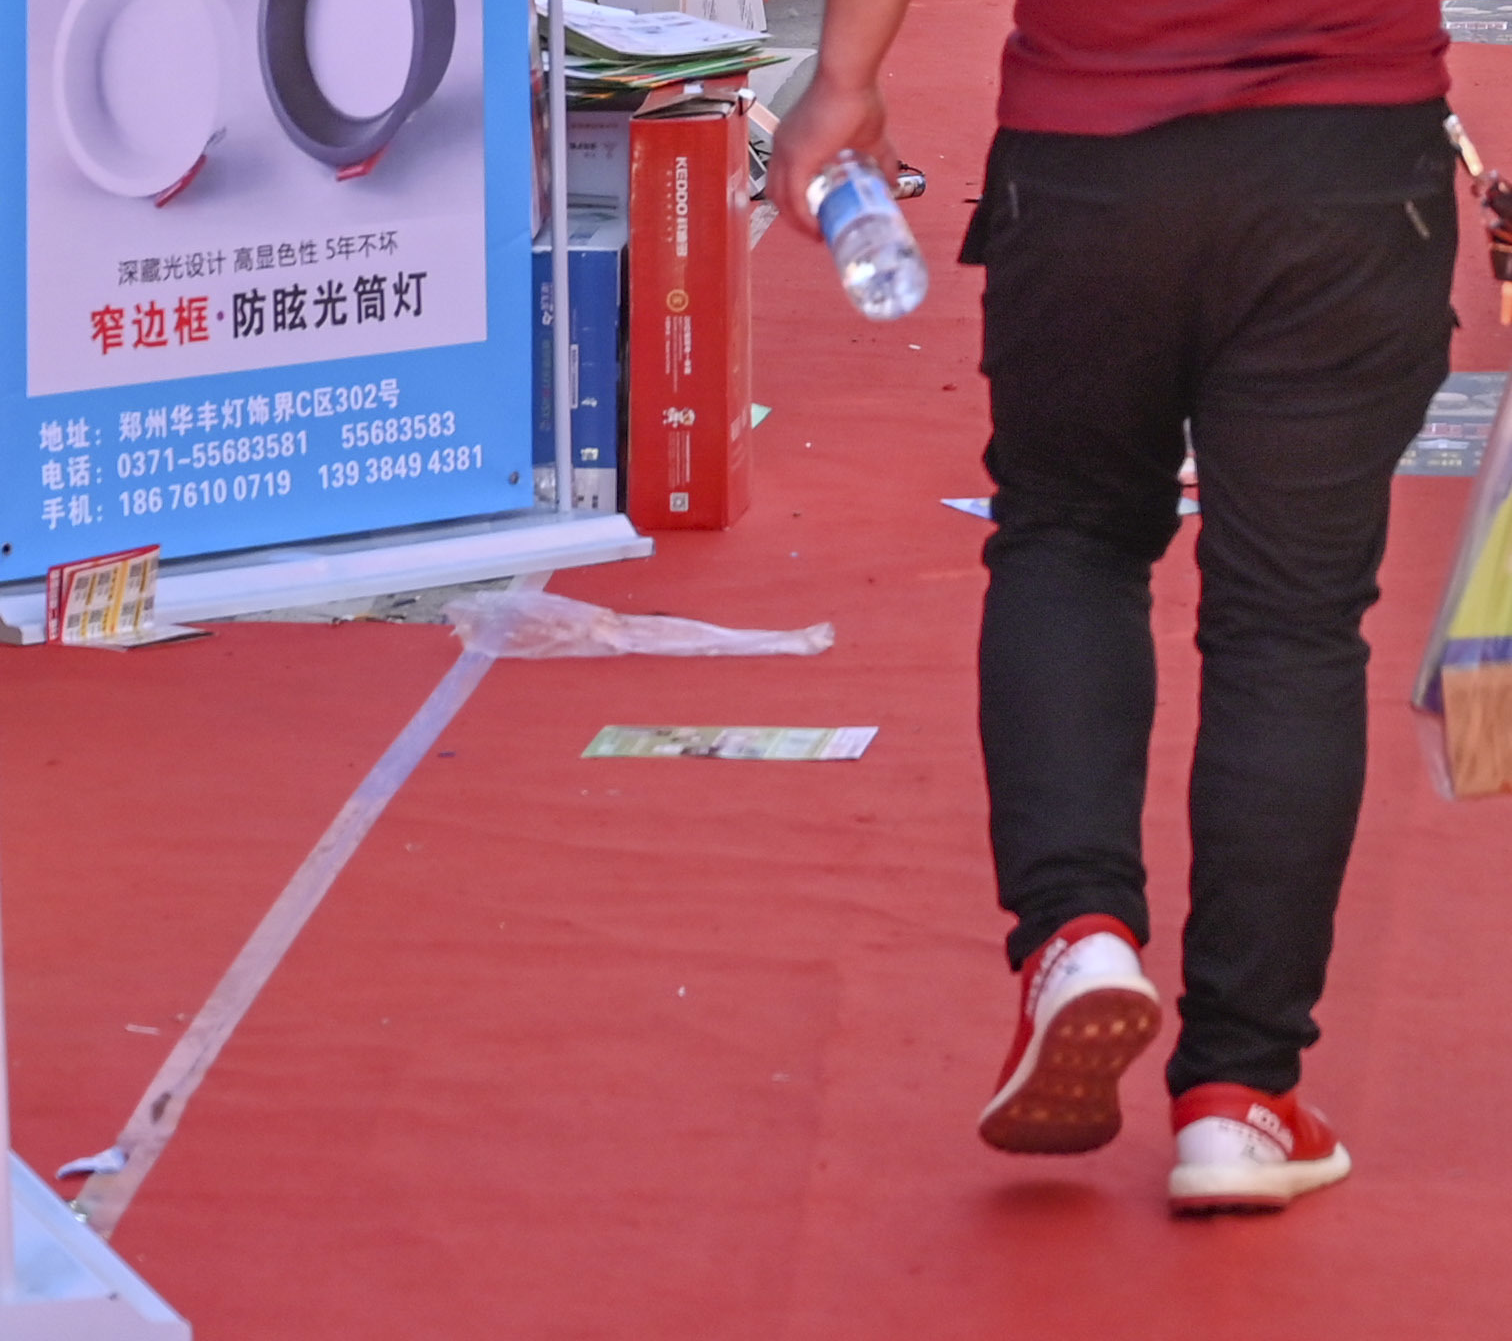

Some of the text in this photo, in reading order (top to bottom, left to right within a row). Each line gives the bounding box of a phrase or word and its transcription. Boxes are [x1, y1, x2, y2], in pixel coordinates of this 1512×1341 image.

[117, 231, 400, 286] 深藏光设计 高显色性 5年不坏
[90, 271, 427, 355] 窄边框·防眩光筒灯
[40, 379, 400, 451] 地址： 郑州华丰灯饰界C区302号
[41, 412, 456, 491] 电话： 0371-55683581 55683583
[42, 445, 484, 530] 手机： 186 7610 0719 139 3849 4381
